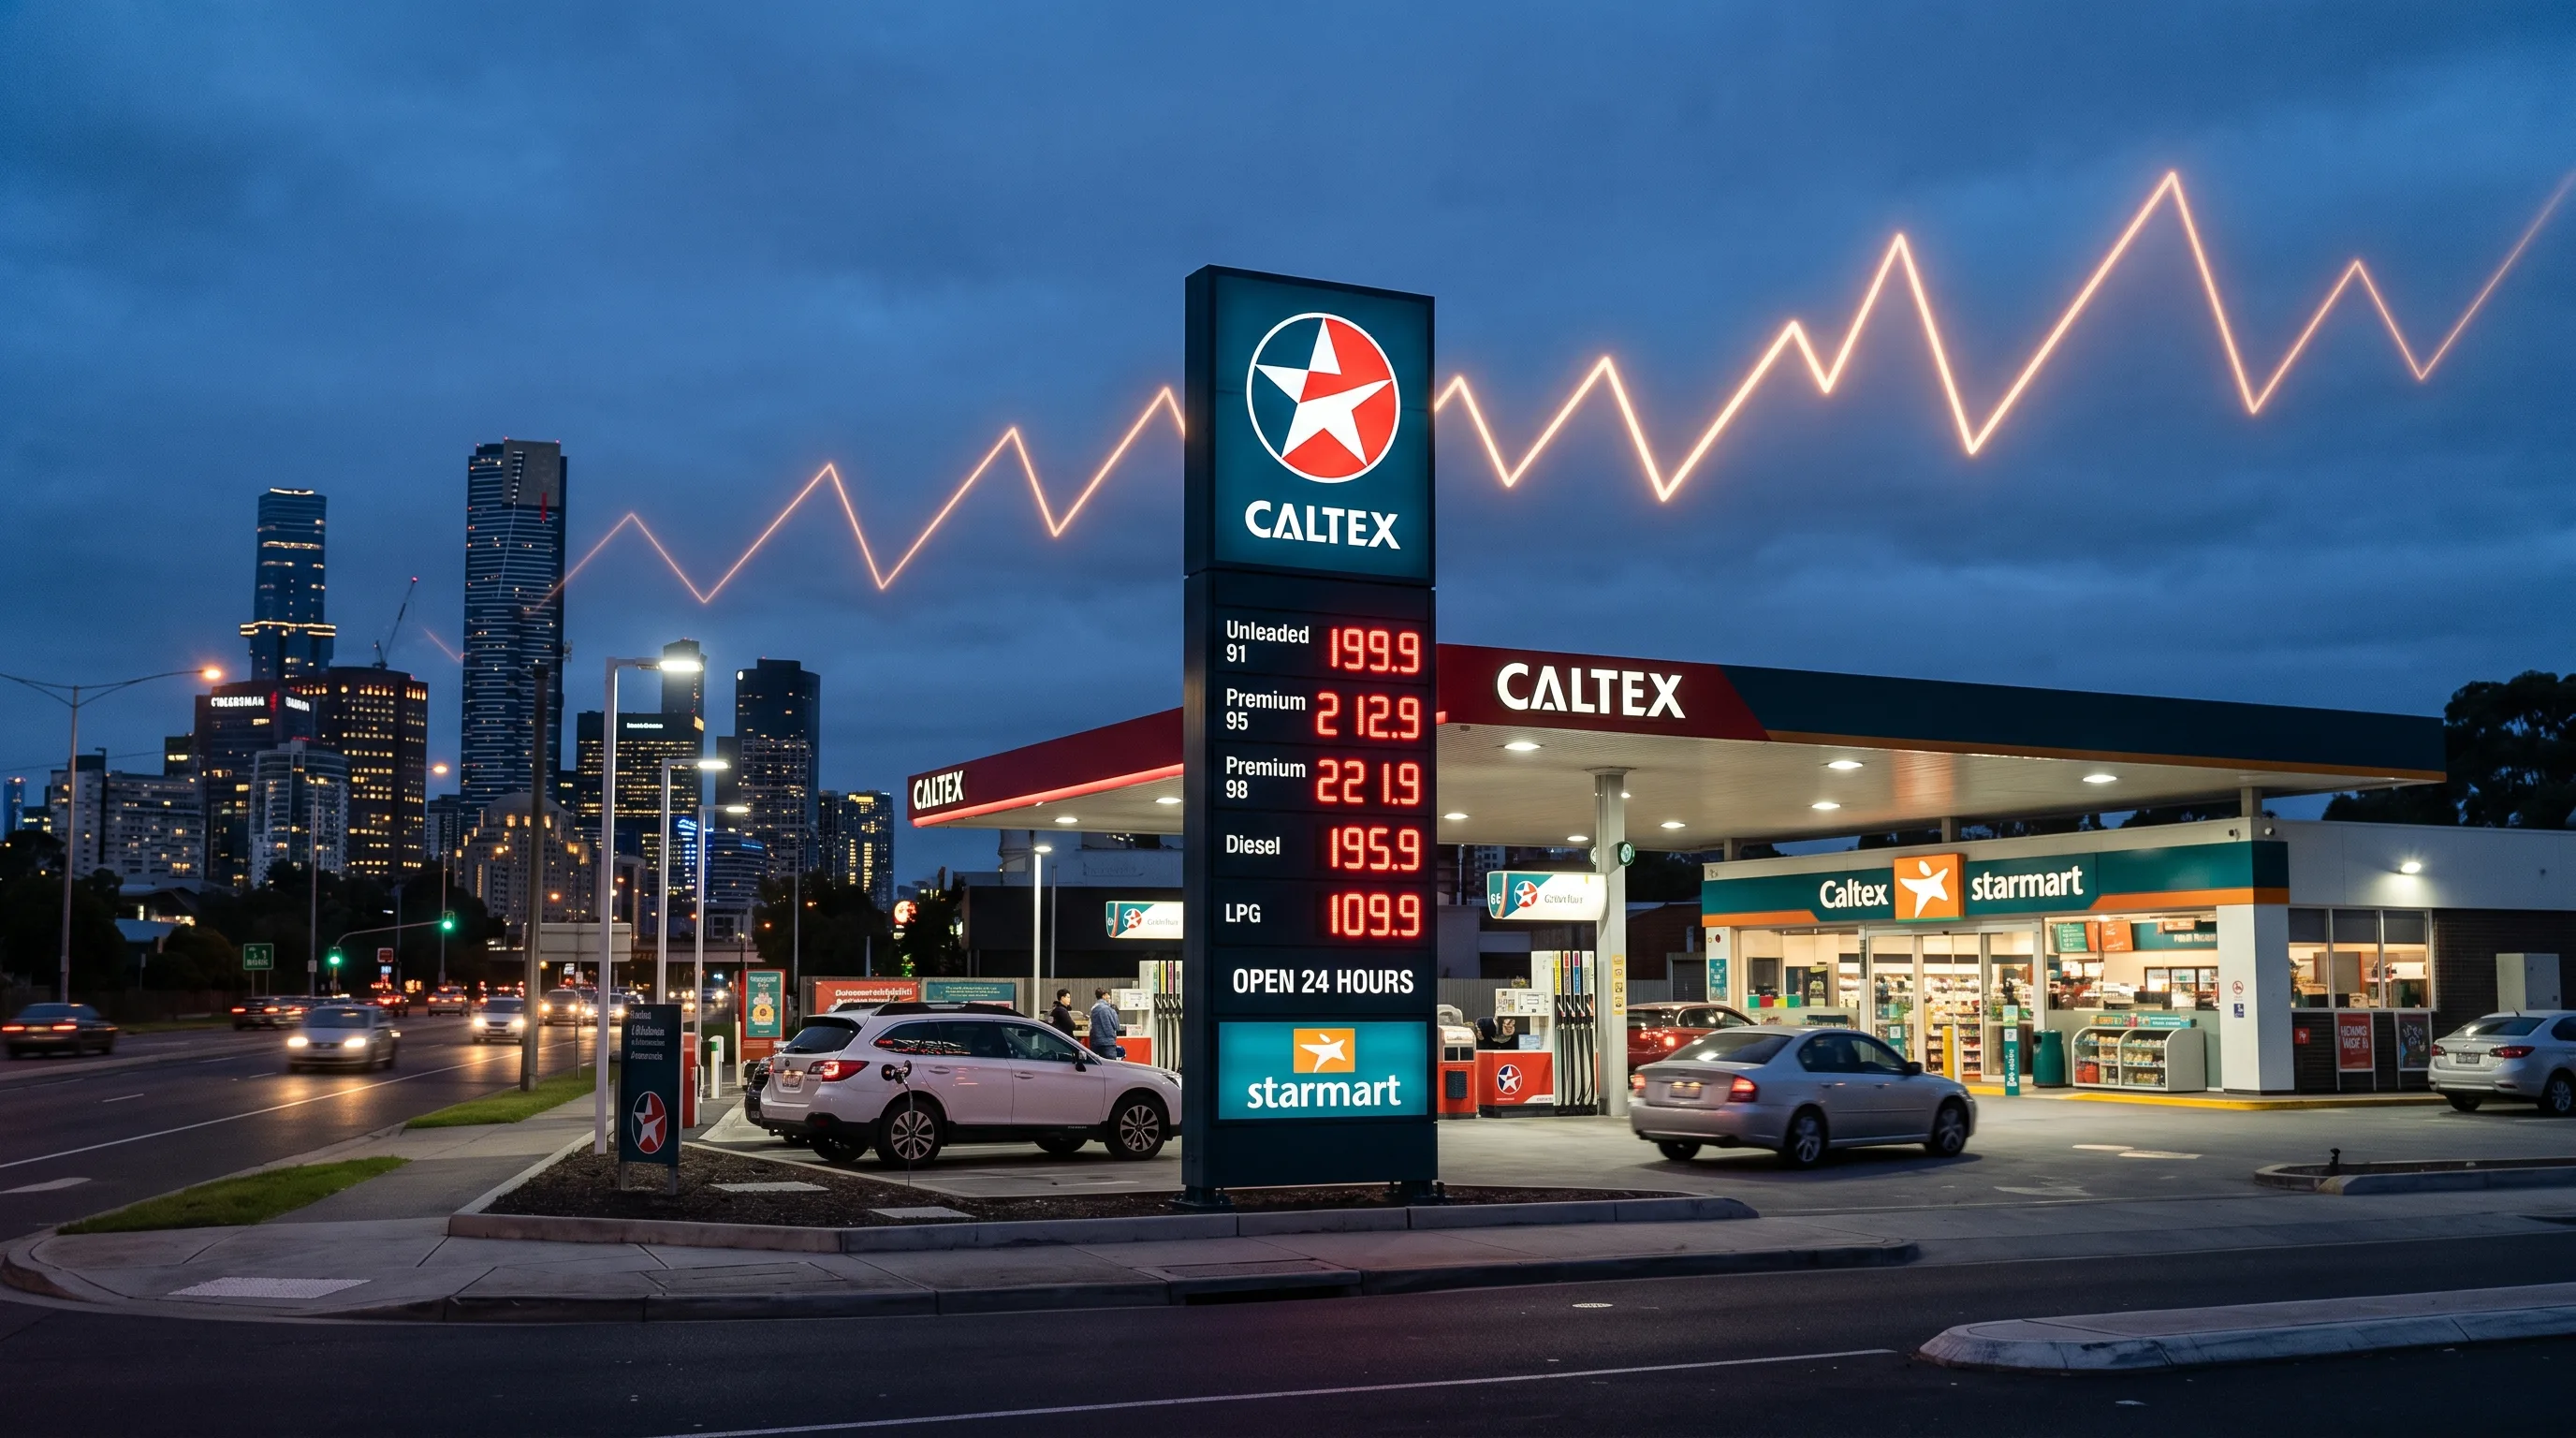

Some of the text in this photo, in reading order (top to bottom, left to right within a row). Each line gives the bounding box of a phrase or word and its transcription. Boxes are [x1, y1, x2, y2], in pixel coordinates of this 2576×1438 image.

[1244, 499, 1401, 550] CALTEX
[1226, 620, 1310, 644] Unleaded
[1226, 644, 1247, 663] 91
[1330, 628, 1419, 673] 199.9
[1225, 688, 1306, 712] Premium
[1497, 662, 1686, 719] CALTEX
[1225, 711, 1249, 731] 95
[1316, 692, 1419, 739] 212.9
[1225, 756, 1307, 778] Premium
[1316, 759, 1419, 805] 221.9
[913, 770, 964, 811] CALTEX
[1225, 779, 1249, 800] 98
[1225, 834, 1281, 855] Diesel
[1330, 827, 1420, 871] 195.9
[1819, 878, 1889, 909] Caltex
[1971, 865, 2084, 902] starmart
[1225, 902, 1261, 923] LPG
[1330, 893, 1420, 936] 109.9
[1232, 968, 1414, 994] OPEN 24 HOURS
[1246, 1074, 1402, 1109] starmart
